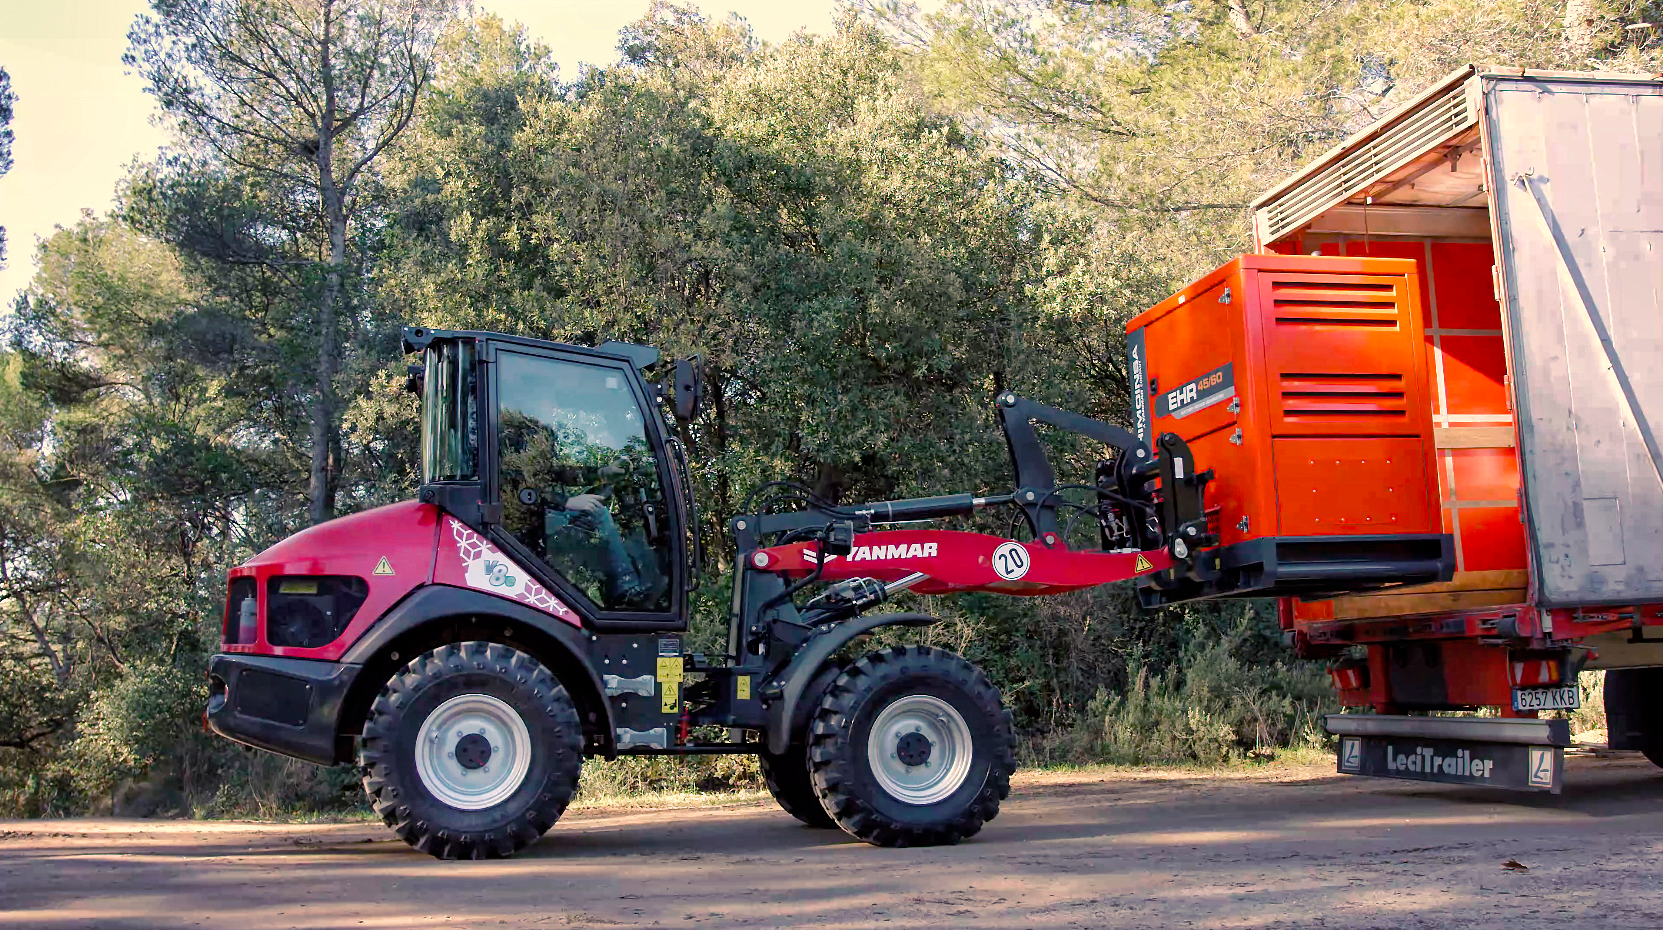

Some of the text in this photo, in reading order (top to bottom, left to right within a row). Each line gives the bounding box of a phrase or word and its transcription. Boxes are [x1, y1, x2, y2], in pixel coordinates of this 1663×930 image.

[1168, 371, 1223, 411] EHR 45/60
[846, 542, 938, 562] YANMAR
[998, 548, 1024, 575] 20
[1520, 689, 1575, 708] 6257 KKB
[1387, 745, 1493, 778] LeciTrailer
